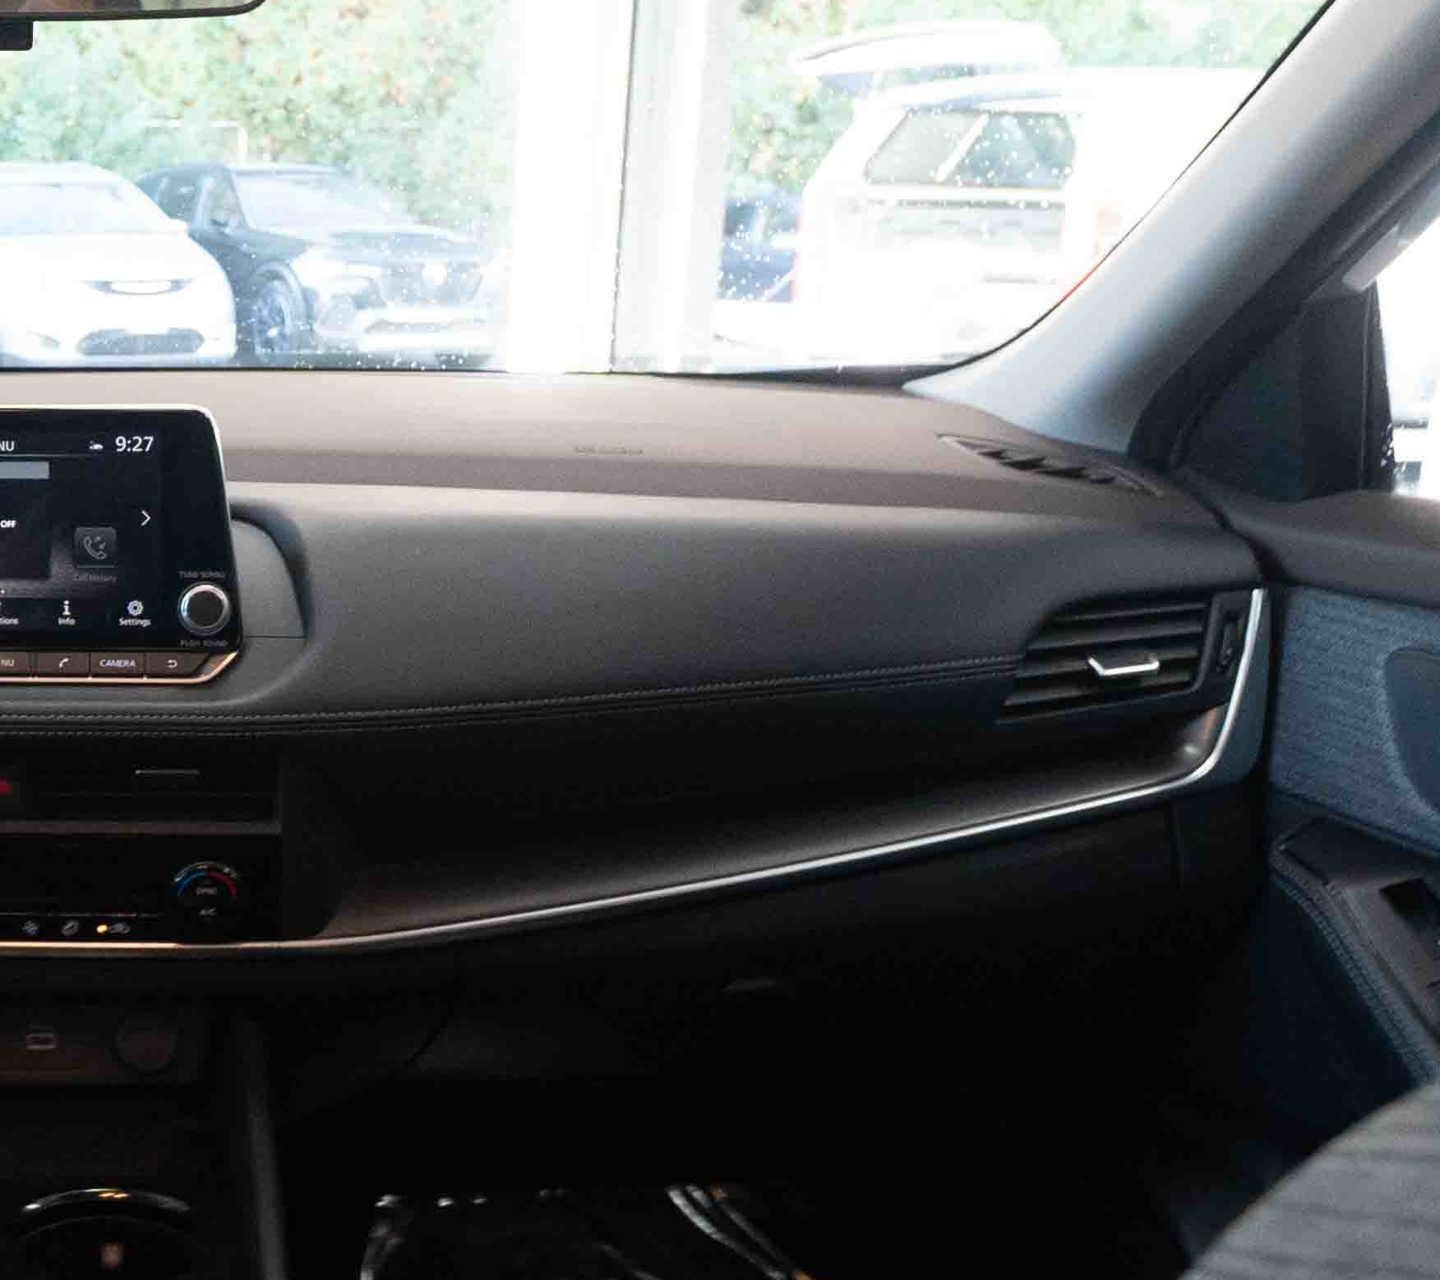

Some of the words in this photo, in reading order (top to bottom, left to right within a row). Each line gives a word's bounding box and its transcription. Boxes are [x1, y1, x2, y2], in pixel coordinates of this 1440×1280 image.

[115, 435, 155, 454] 9:27
[0, 520, 17, 529] OFF
[58, 617, 76, 626] Info
[119, 618, 152, 629] Settings
[99, 658, 136, 668] CAMERA
